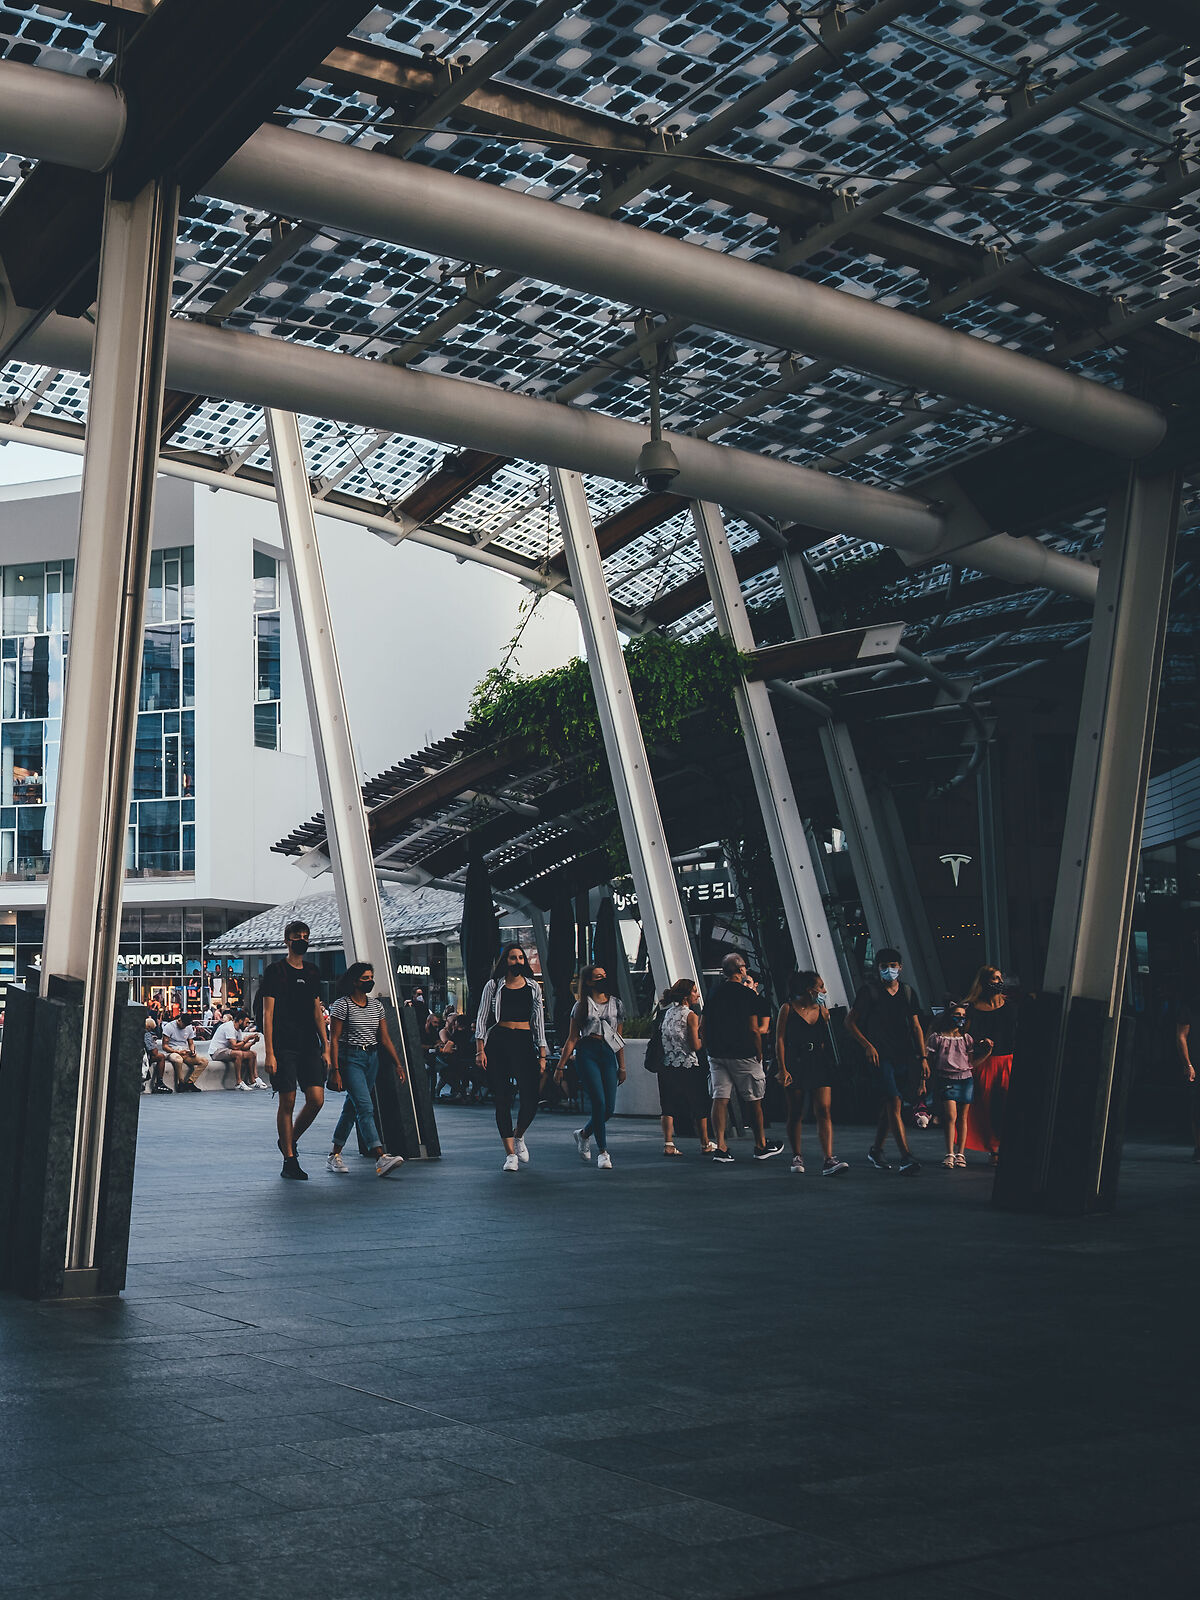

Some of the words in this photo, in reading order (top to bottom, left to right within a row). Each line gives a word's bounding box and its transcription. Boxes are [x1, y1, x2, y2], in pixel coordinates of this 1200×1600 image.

[682, 881, 736, 902] TESL
[612, 889, 638, 911] yso
[117, 954, 184, 965] ARMOUR
[396, 964, 431, 976] ARMOUR
